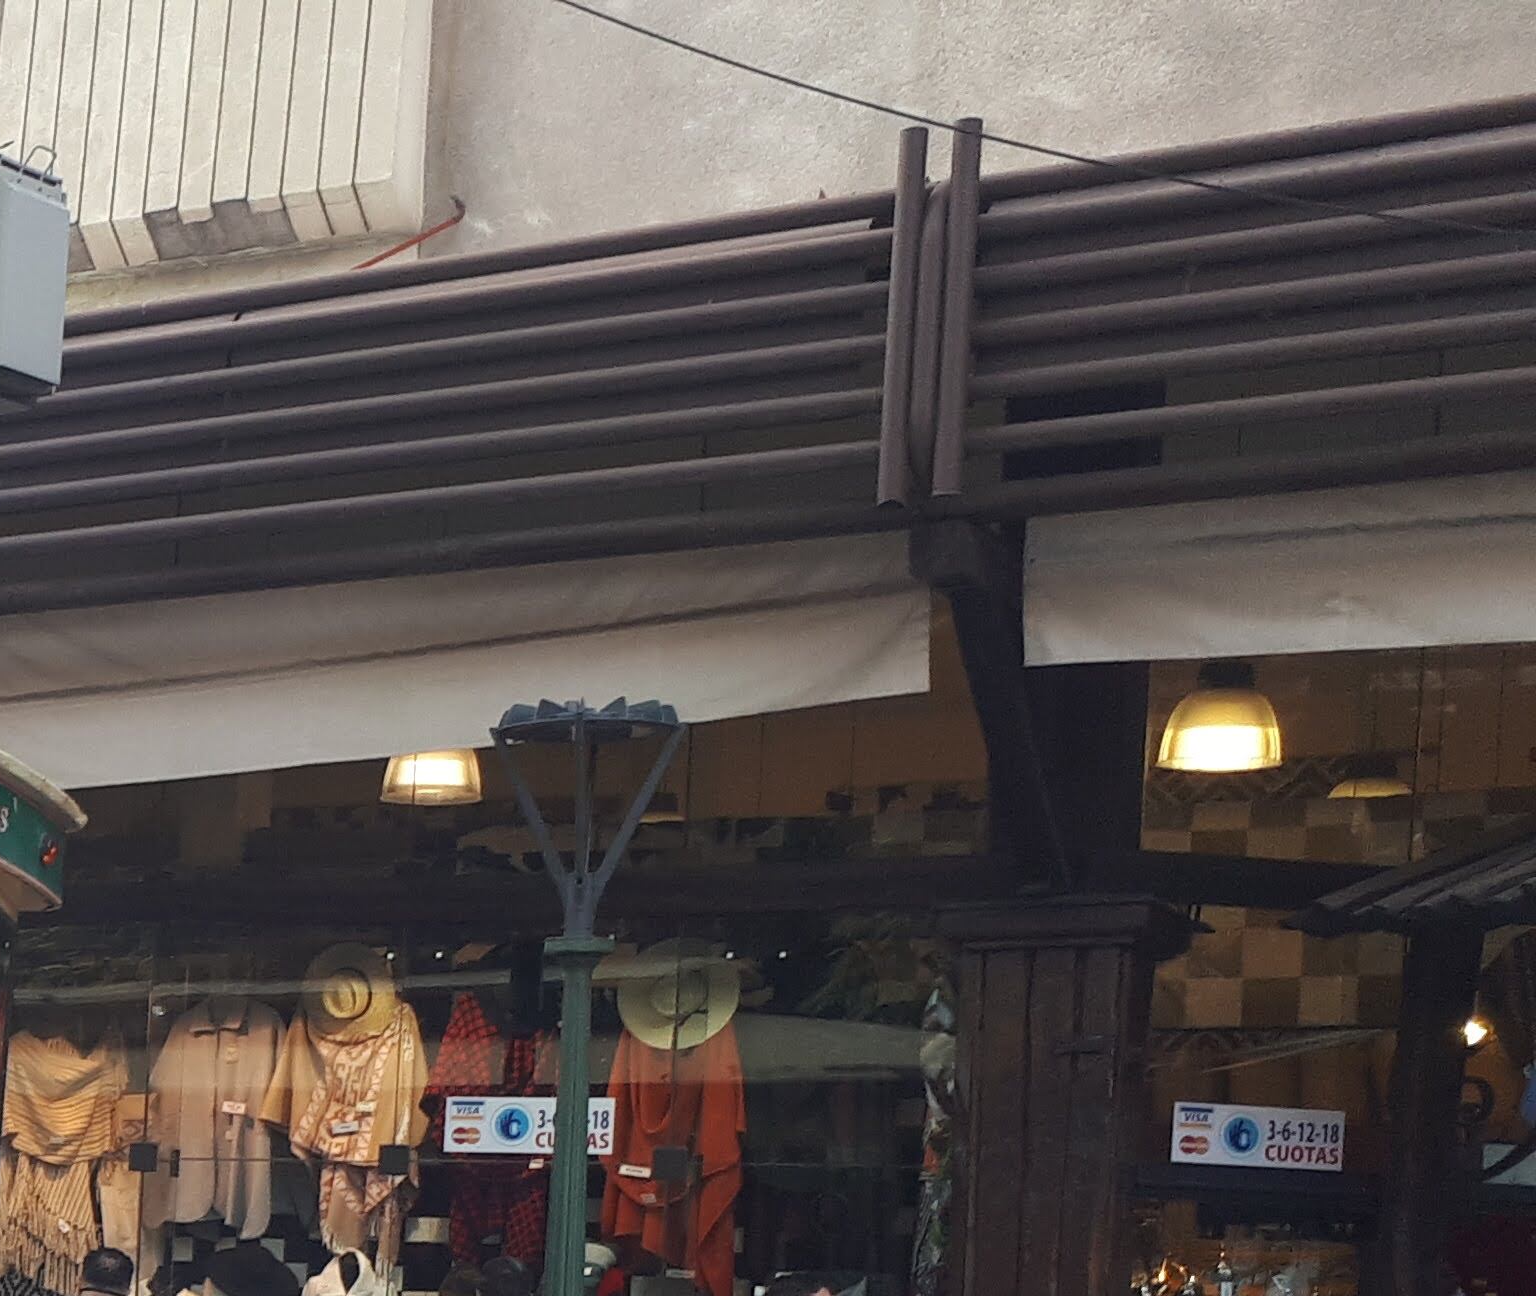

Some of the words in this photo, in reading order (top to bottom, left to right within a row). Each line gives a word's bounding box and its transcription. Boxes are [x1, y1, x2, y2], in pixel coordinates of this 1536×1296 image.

[456, 1107, 480, 1115] VISA
[1184, 1113, 1209, 1122] VISA
[1267, 1120, 1339, 1143] 3-6-12-18
[1265, 1144, 1339, 1165] CUOTAS
